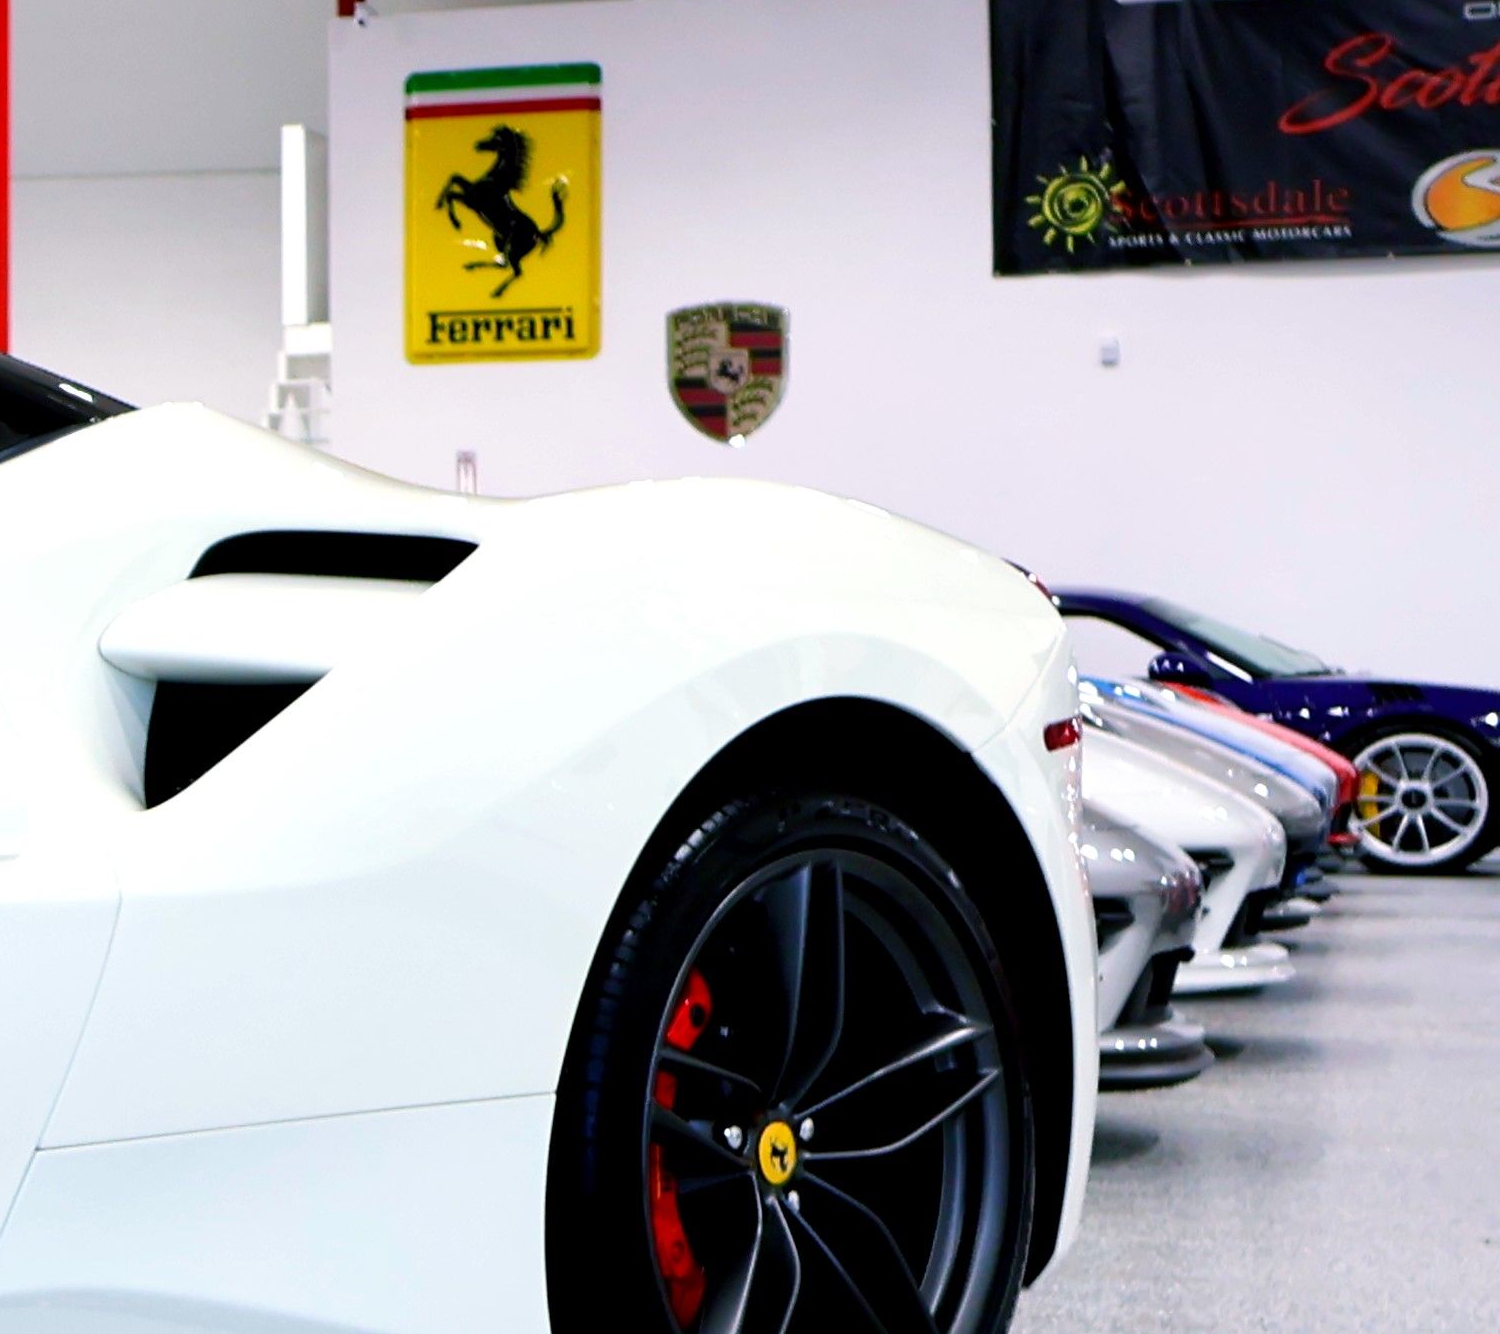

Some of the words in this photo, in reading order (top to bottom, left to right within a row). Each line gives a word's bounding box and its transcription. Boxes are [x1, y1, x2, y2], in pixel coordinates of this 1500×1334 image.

[1184, 229, 1245, 247] CLASSIC
[1252, 224, 1353, 242] MOTORCARS
[426, 307, 575, 344] Ferrari
